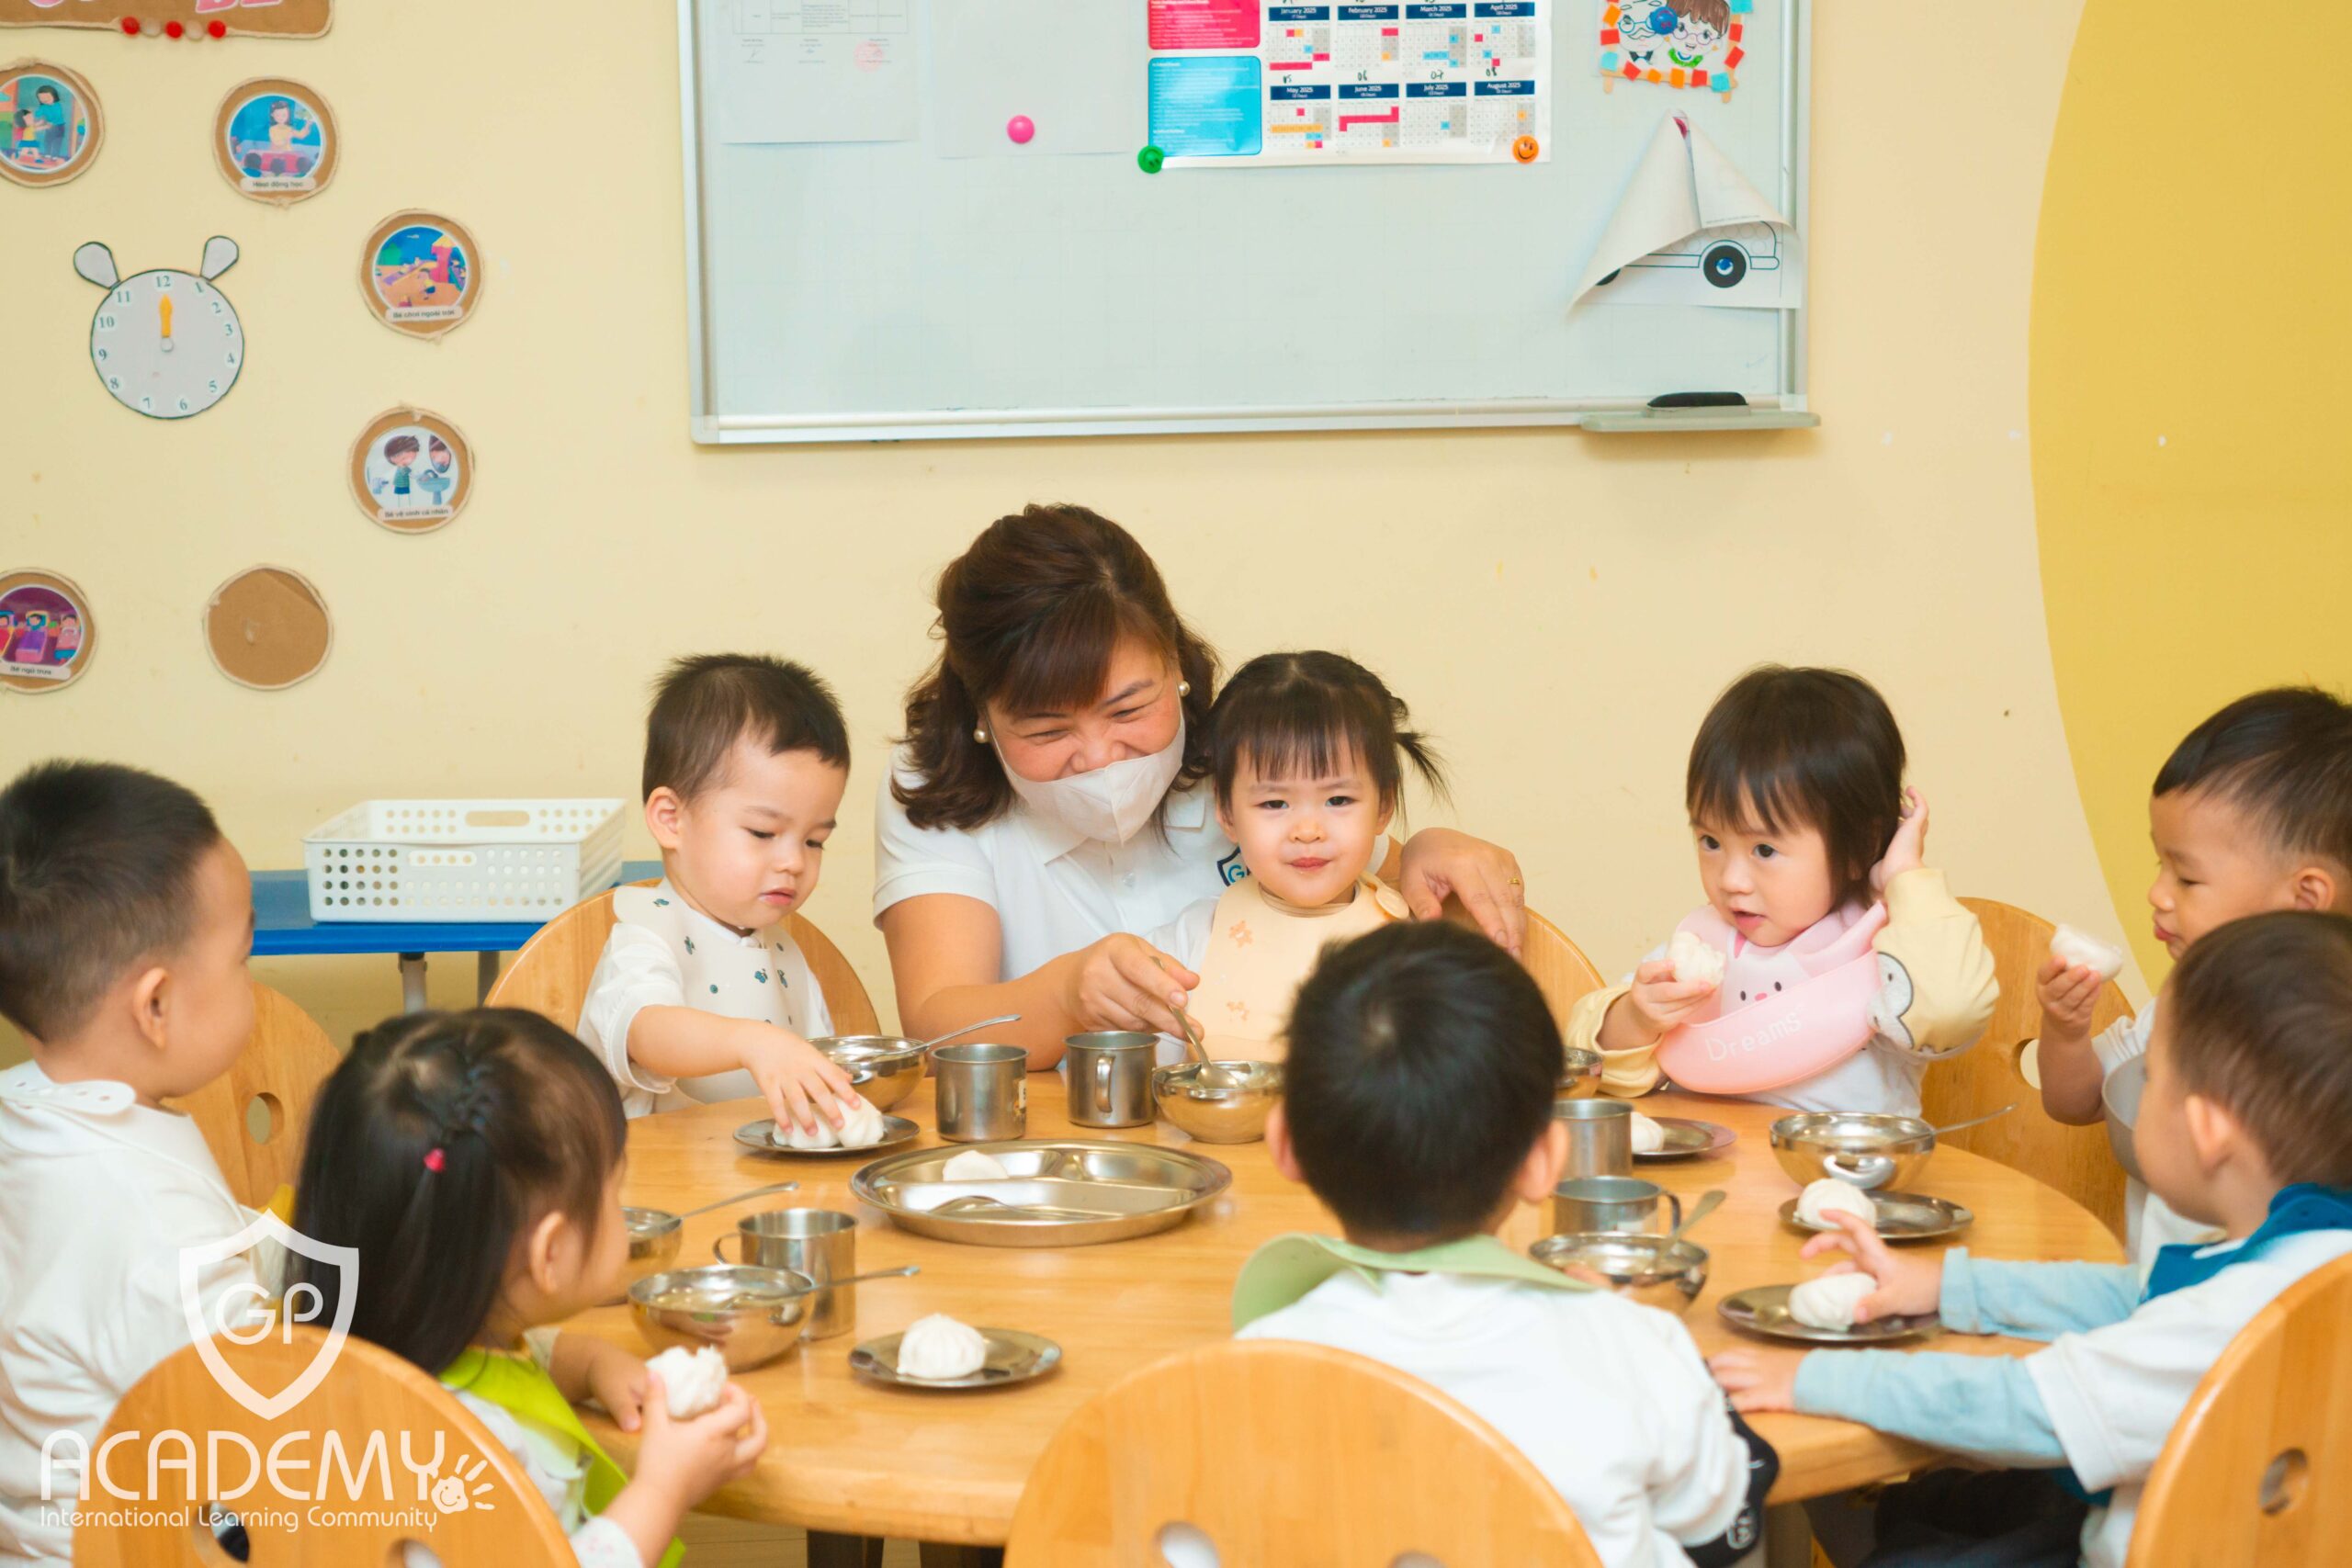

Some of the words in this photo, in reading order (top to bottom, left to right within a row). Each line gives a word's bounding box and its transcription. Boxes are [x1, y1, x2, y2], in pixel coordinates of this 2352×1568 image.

[1348, 6, 1374, 15] February
[155, 275, 171, 288] 12
[195, 281, 204, 293] 1
[117, 290, 130, 303] 11
[211, 301, 221, 314] 2
[99, 316, 115, 328] 10
[225, 323, 233, 336] 3
[98, 348, 107, 360] 9
[227, 353, 235, 364] 4
[109, 377, 119, 389] 8
[209, 380, 218, 393] 5
[142, 397, 151, 409] 7
[179, 398, 188, 411] 6
[1705, 1010, 1803, 1062] Dreams
